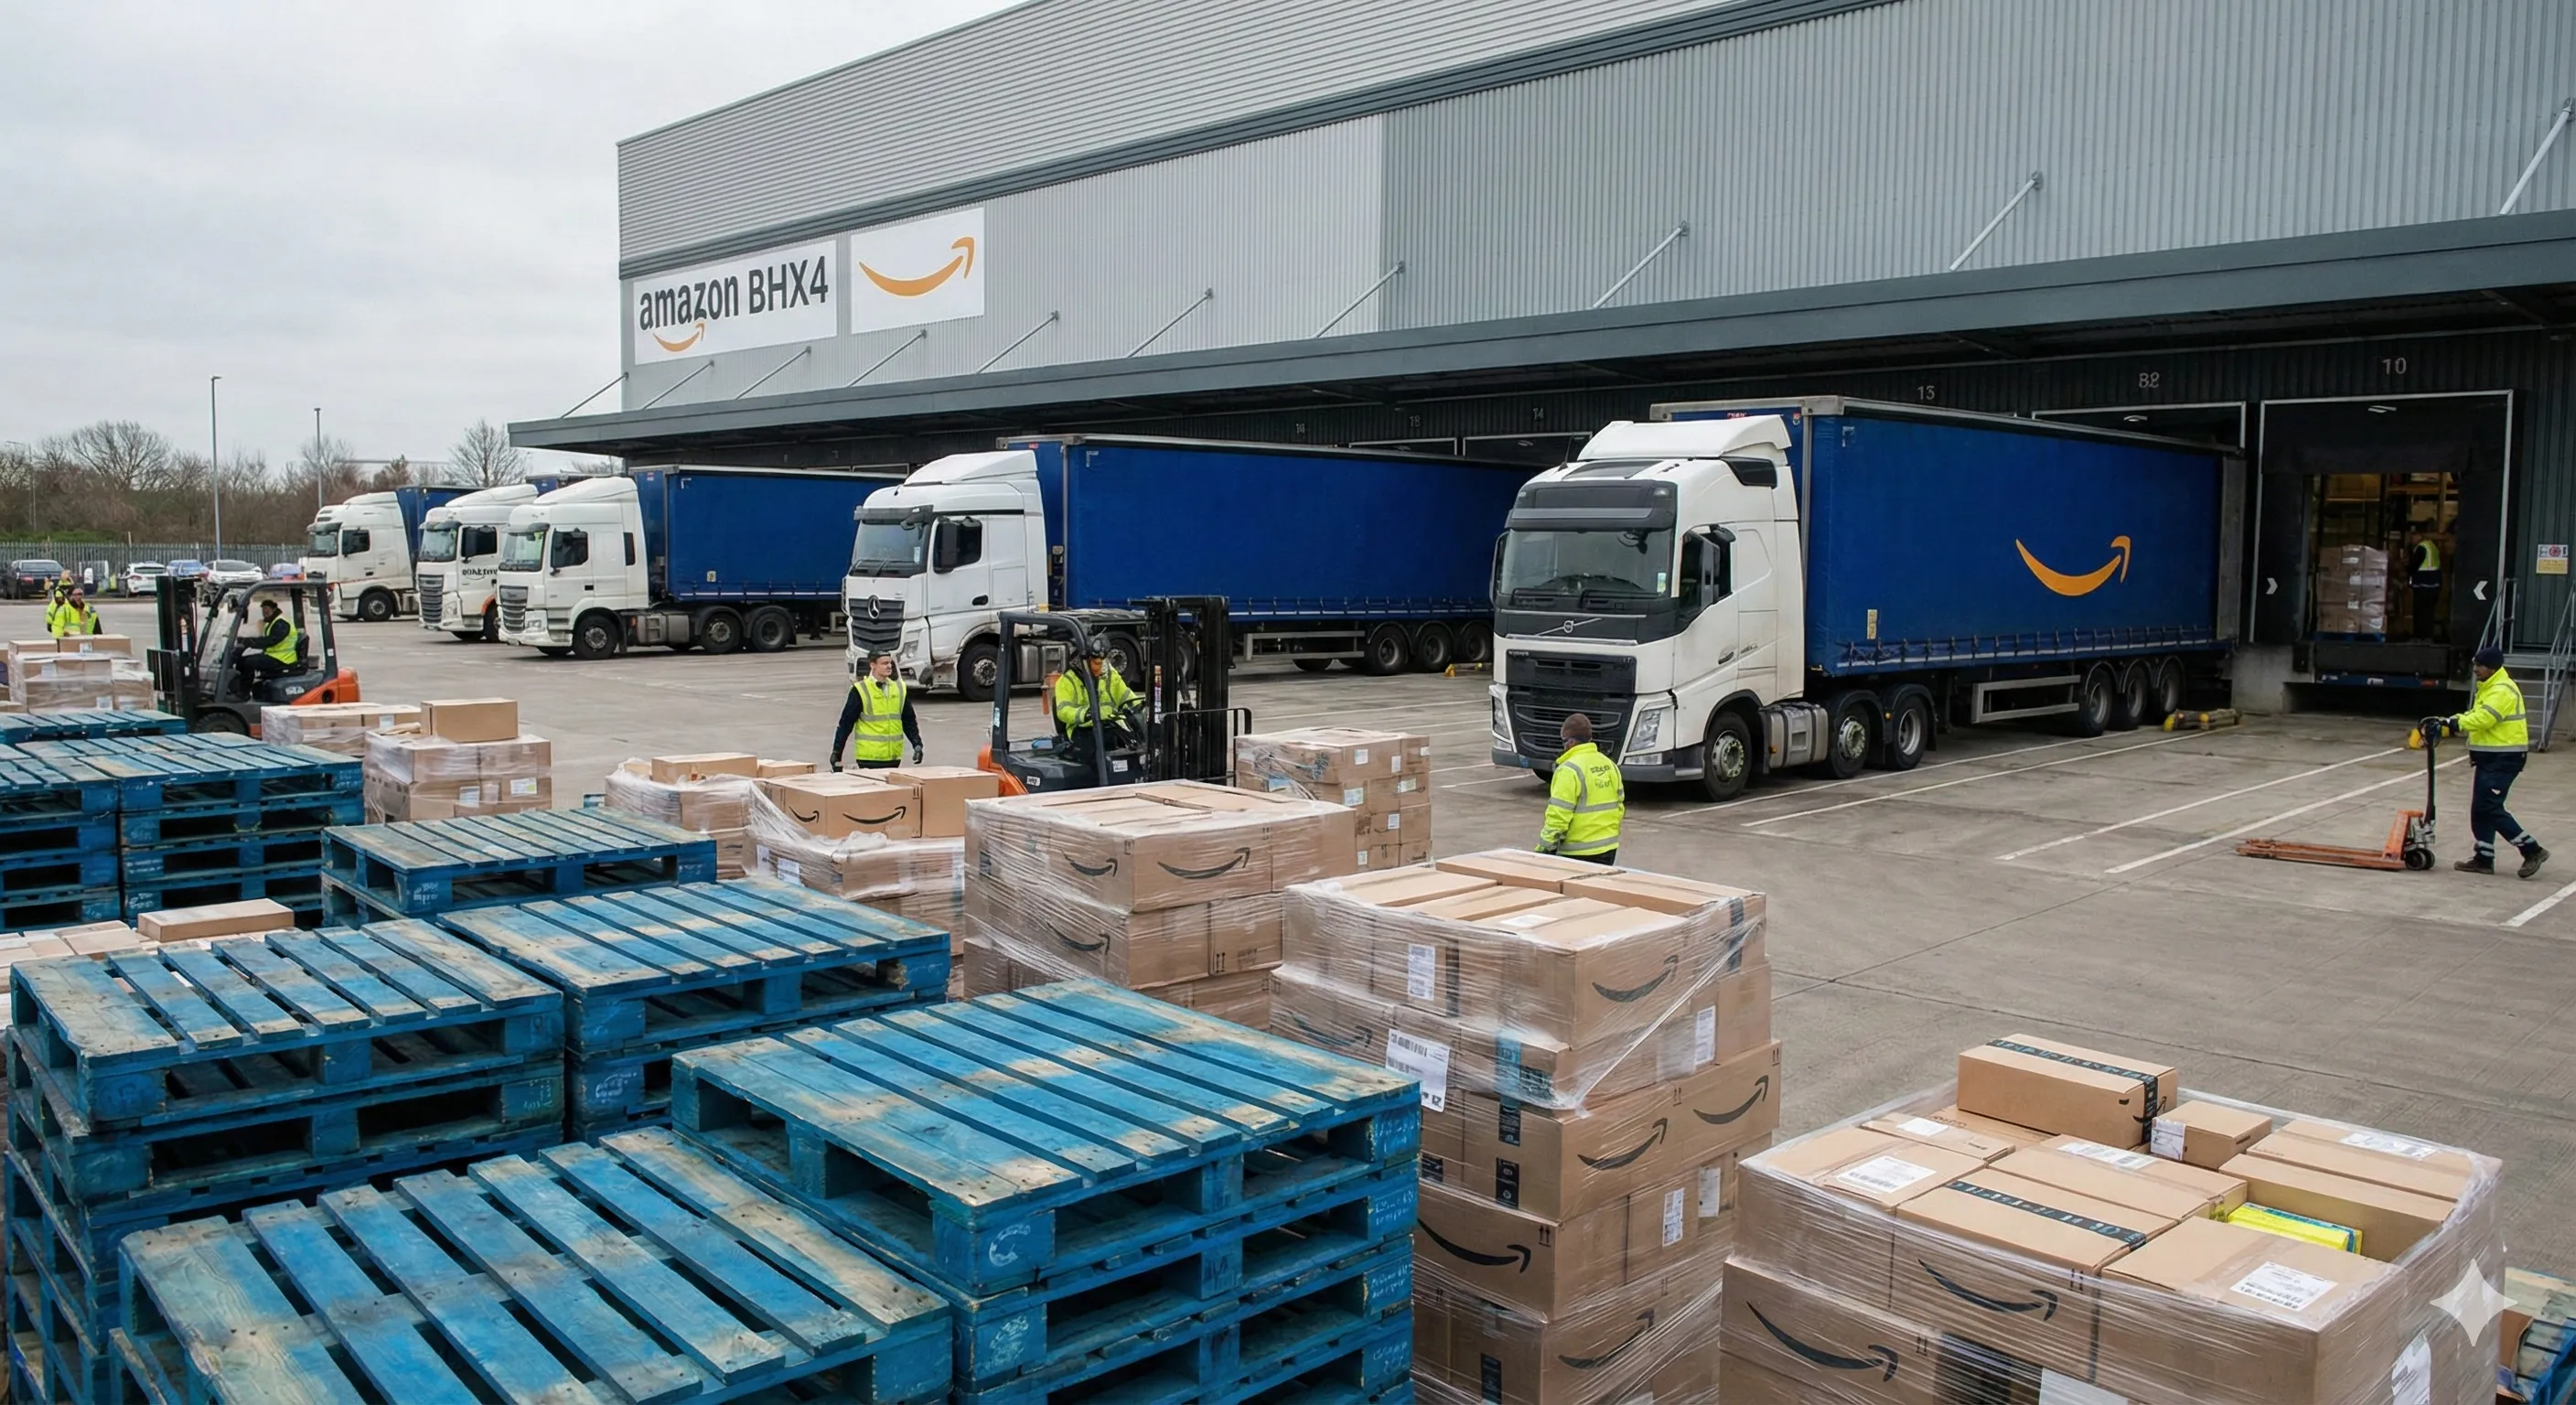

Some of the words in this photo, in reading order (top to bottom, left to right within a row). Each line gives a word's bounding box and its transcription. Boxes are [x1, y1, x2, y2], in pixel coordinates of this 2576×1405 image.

[639, 276, 739, 330] amazon
[749, 255, 829, 314] BHX4
[2382, 357, 2407, 374] 10
